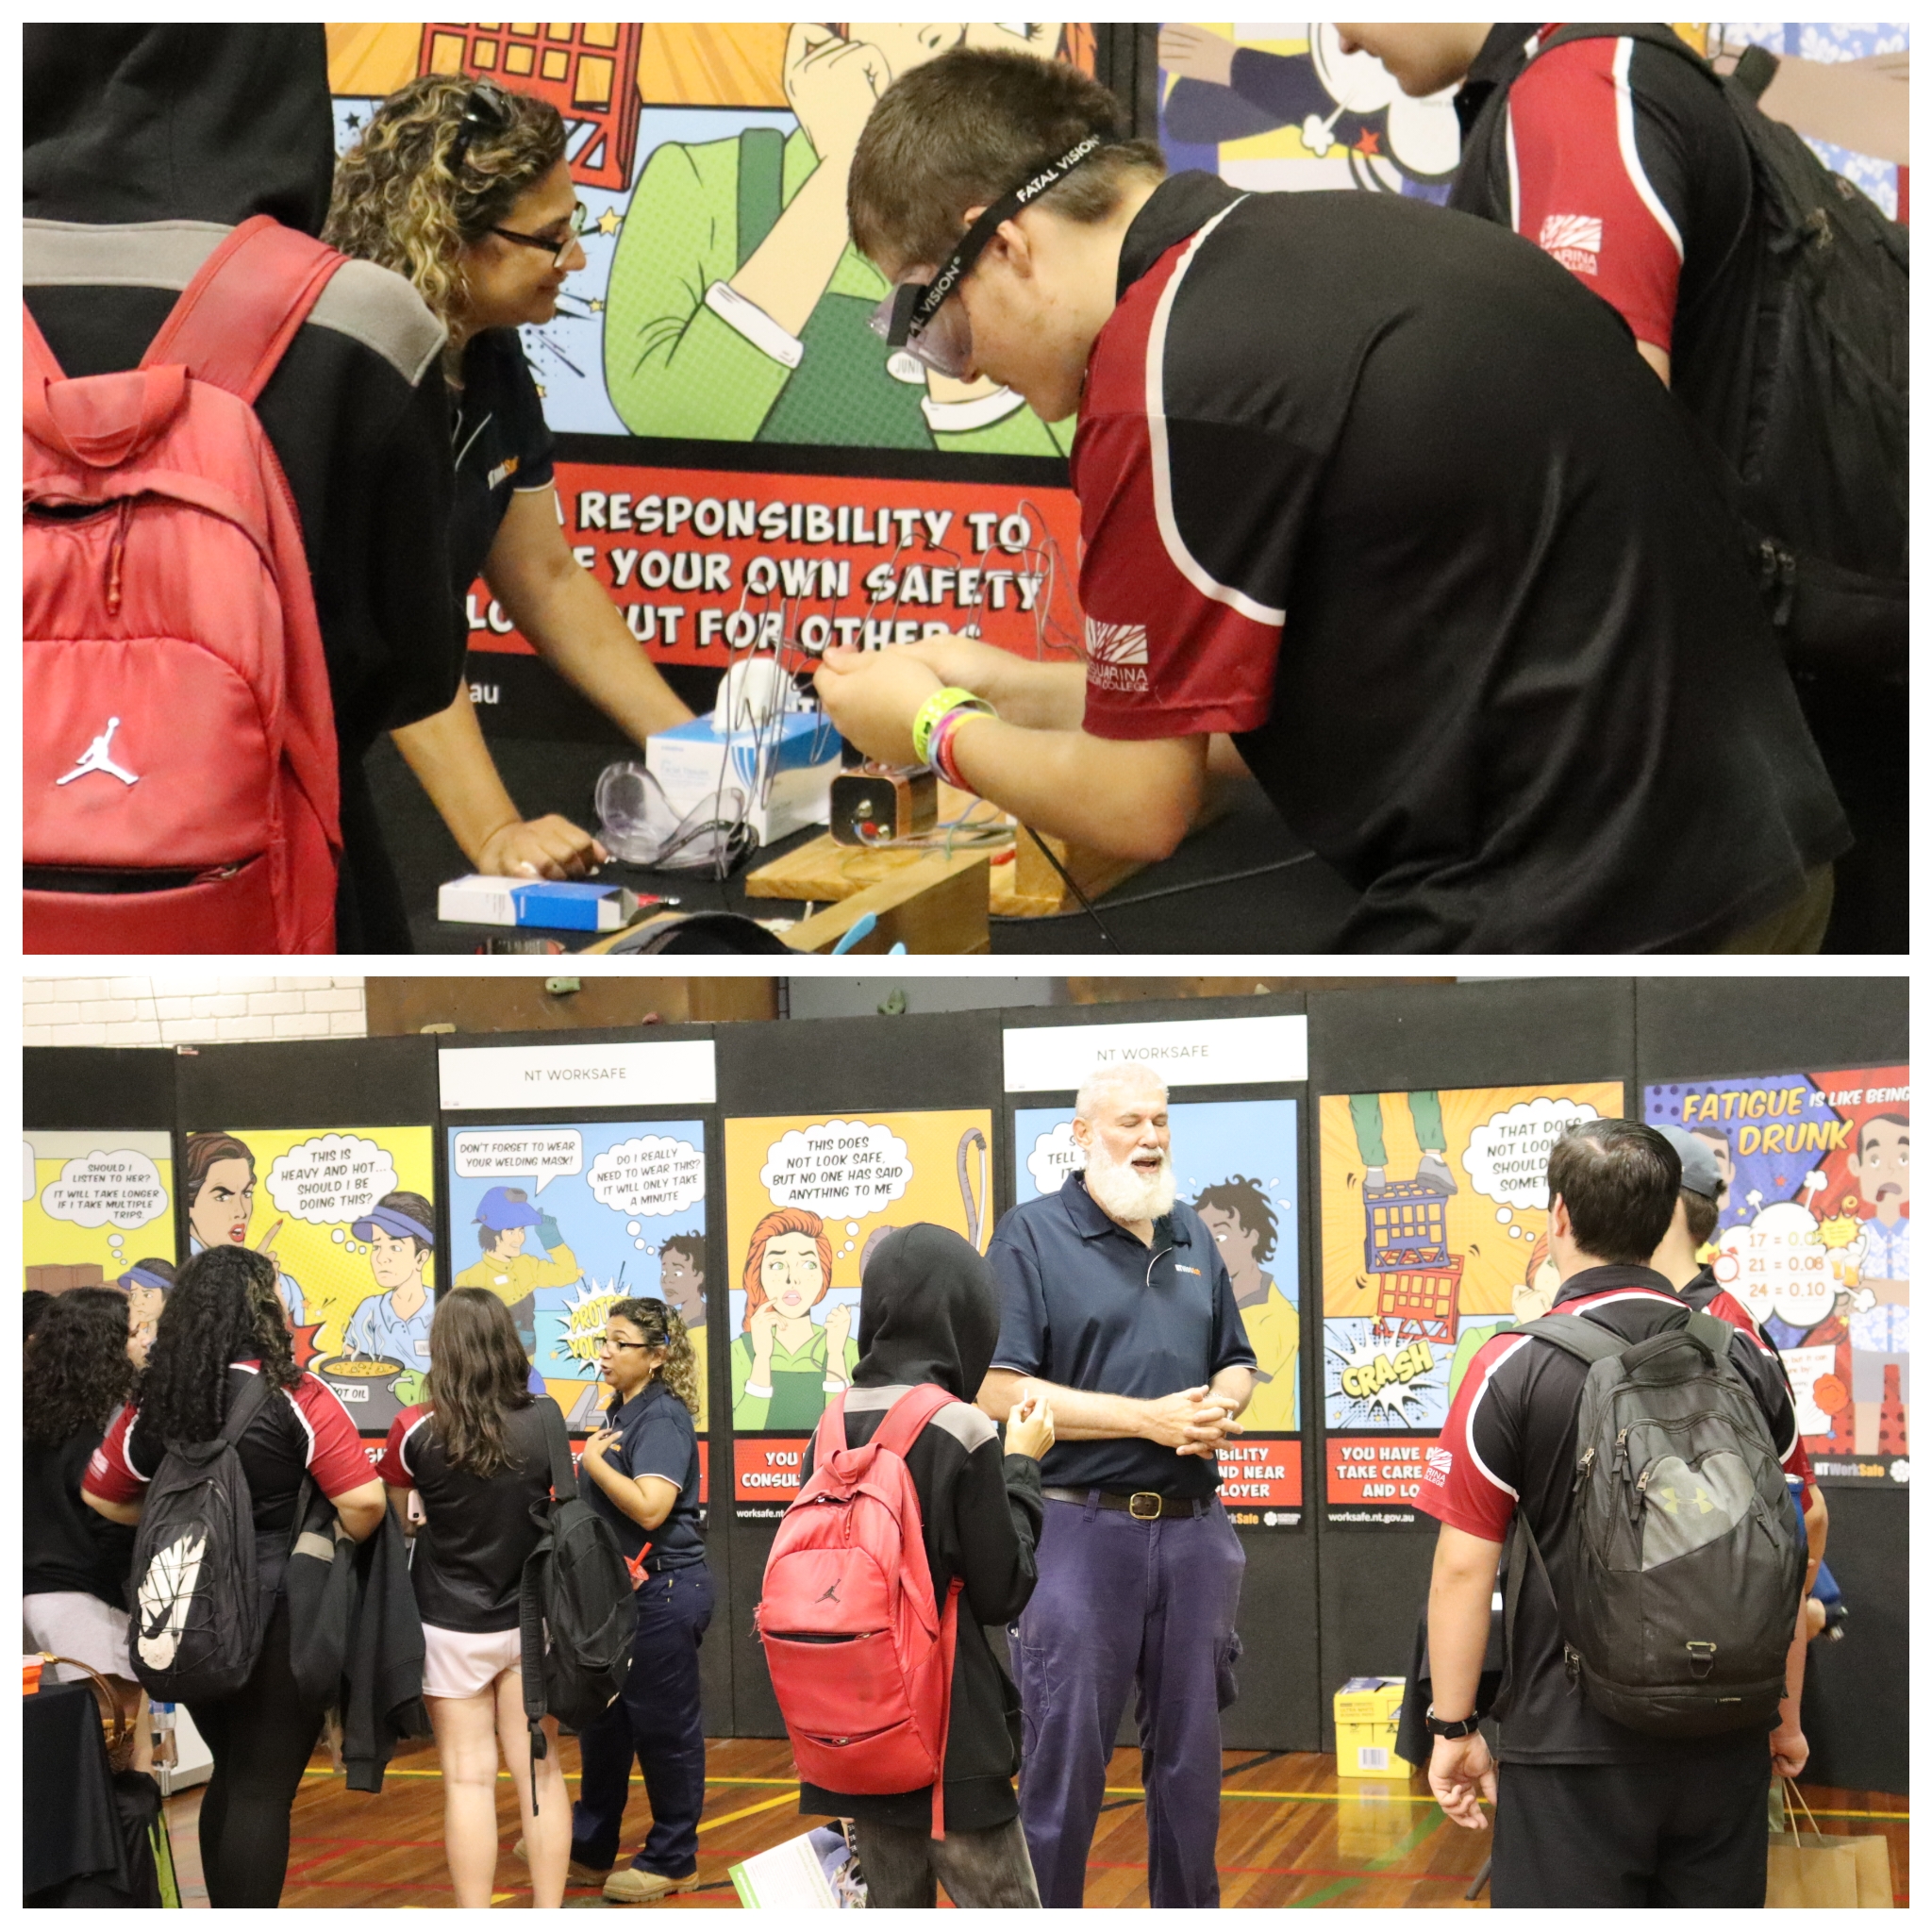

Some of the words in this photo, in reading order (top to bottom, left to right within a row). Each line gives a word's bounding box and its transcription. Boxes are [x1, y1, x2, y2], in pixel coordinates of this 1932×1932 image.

[1017, 169, 1058, 203] FATAL
[577, 491, 952, 549] RESPONSIBILITY
[968, 512, 1031, 555] TO
[609, 548, 731, 591] YOUR
[746, 556, 850, 599] OWN
[865, 562, 1043, 610] SAFETY
[616, 604, 685, 644] UT
[699, 608, 783, 649] FOR
[1102, 680, 1149, 691] COLLEGE
[1096, 1049, 1116, 1061] NT
[1122, 1044, 1209, 1060] WORKSAFE
[525, 1070, 542, 1082] NT
[546, 1068, 626, 1081] WORKSAFE
[1681, 1086, 1807, 1123] FATIGUE
[1808, 1092, 1826, 1108] IS
[1828, 1089, 1863, 1107] LIKE
[1865, 1086, 1909, 1105] BEING
[1499, 1122, 1538, 1139] THAT
[1738, 1119, 1856, 1157] DRUNK
[459, 1142, 490, 1153] DON'T
[491, 1142, 529, 1153] FORGET
[531, 1141, 544, 1152] TO
[547, 1141, 575, 1151] WEAR
[807, 1139, 834, 1152] THIS
[838, 1136, 869, 1150] DOES
[1487, 1142, 1516, 1158] NOT
[310, 1150, 337, 1163] THIS
[341, 1148, 352, 1160] IS
[466, 1158, 491, 1167] YOUR
[495, 1157, 538, 1167] WELDING
[541, 1156, 573, 1166] MASK!
[616, 1155, 631, 1165] DO
[641, 1148, 678, 1162] REALLY
[786, 1157, 811, 1169] NOT
[816, 1154, 848, 1167] LOOK
[852, 1151, 886, 1165] SAFE,
[1047, 1151, 1076, 1165] TELL
[88, 1164, 125, 1173] SHOULD
[281, 1167, 320, 1181] HEAVY
[324, 1164, 348, 1177] AND
[597, 1170, 622, 1182] NEED
[625, 1168, 639, 1178] TO
[641, 1163, 670, 1176] WEAR
[673, 1158, 701, 1173] THIS?
[1492, 1157, 1548, 1174] SHOULD
[73, 1174, 106, 1183] LISTEN
[125, 1174, 151, 1183] HER?
[773, 1173, 796, 1186] BUT
[800, 1173, 817, 1184] NO
[821, 1170, 844, 1183] ONE
[848, 1168, 872, 1181] HAS
[874, 1166, 903, 1179] SAID
[297, 1180, 342, 1195] SHOULD
[355, 1177, 370, 1190] BE
[603, 1186, 613, 1195] IT
[616, 1182, 640, 1194] WILL
[643, 1178, 669, 1191] ONLY
[672, 1174, 698, 1186] TAKE
[788, 1186, 850, 1201] ANYTHING
[854, 1184, 870, 1196] TO
[874, 1183, 893, 1195] ME
[94, 1190, 119, 1198] TAKE
[122, 1190, 159, 1198] LONGER
[299, 1196, 336, 1210] DOING
[340, 1192, 374, 1207] THIS?
[630, 1196, 638, 1207] A
[641, 1191, 679, 1205] MINUTE
[106, 1200, 153, 1208] MULTIPLE
[113, 1210, 144, 1219] TRIPS.
[1749, 1232, 1767, 1247] 17
[1788, 1231, 1824, 1246] 0.05
[1749, 1257, 1767, 1272] 21
[1789, 1256, 1824, 1271] 0.08
[1749, 1283, 1769, 1297] 24
[1789, 1282, 1825, 1297] 0.10
[570, 1294, 634, 1334] PROT
[1341, 1339, 1435, 1400] CRASH
[352, 1390, 366, 1398] OIL
[765, 1452, 799, 1466] YOU
[1341, 1446, 1375, 1461] YOU
[1378, 1446, 1421, 1461] HAVE
[1243, 1465, 1285, 1479] NEAR
[1336, 1465, 1377, 1479] TAKE
[1381, 1465, 1424, 1479] CARE
[1814, 1462, 1885, 1477] NTWorkSafe
[741, 1473, 800, 1488] CONSUL
[1361, 1483, 1396, 1498] AND
[1327, 1511, 1415, 1524] worksafe.nt.gov.au
